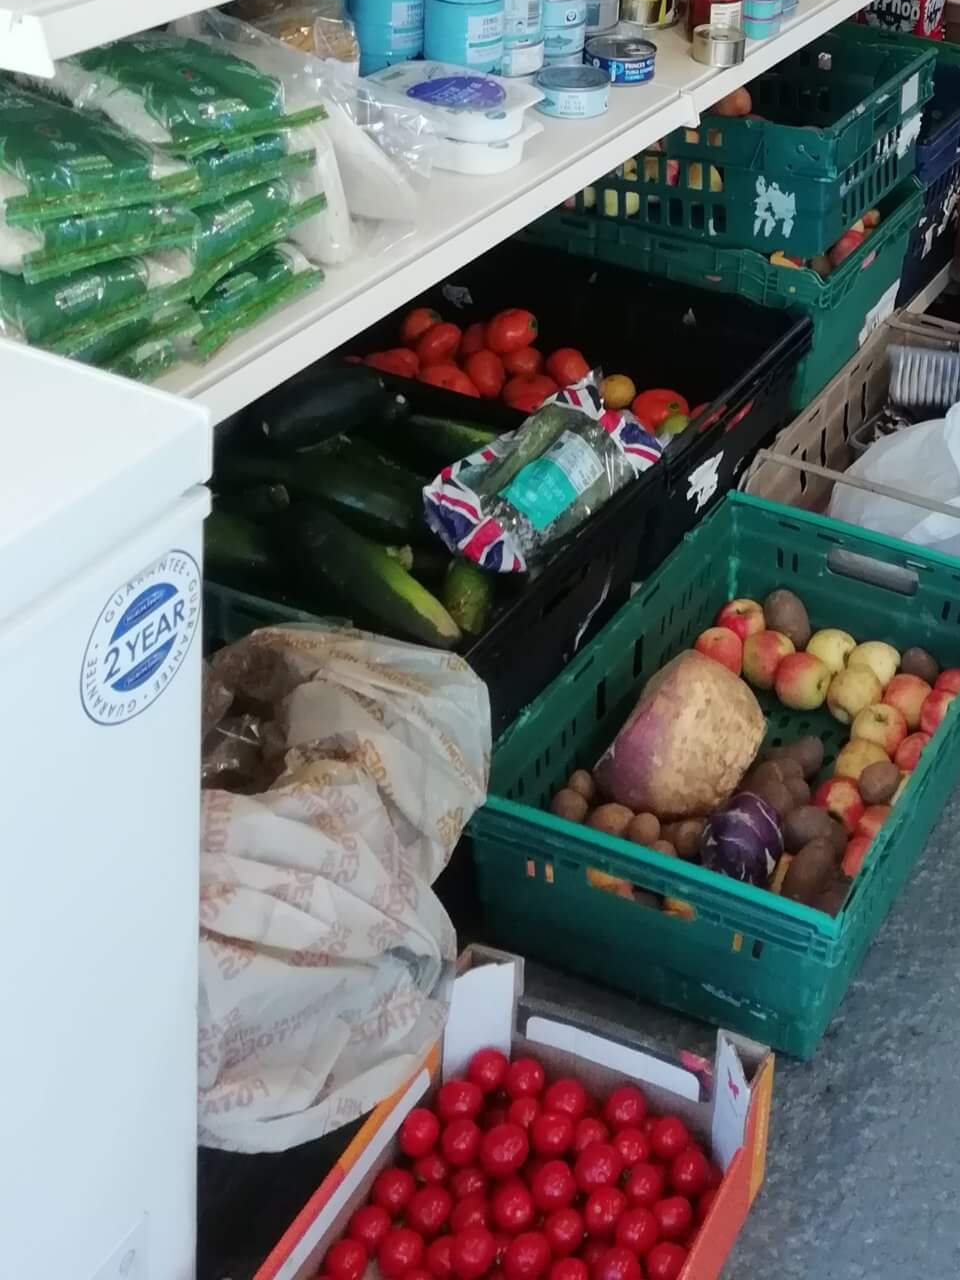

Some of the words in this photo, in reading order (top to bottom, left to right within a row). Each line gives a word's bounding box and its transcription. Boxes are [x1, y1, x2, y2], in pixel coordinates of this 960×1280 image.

[103, 646, 121, 684] 2
[125, 599, 185, 662] YEAR
[154, 579, 198, 693] GUARANTEE
[86, 657, 137, 718] GUARANTEE
